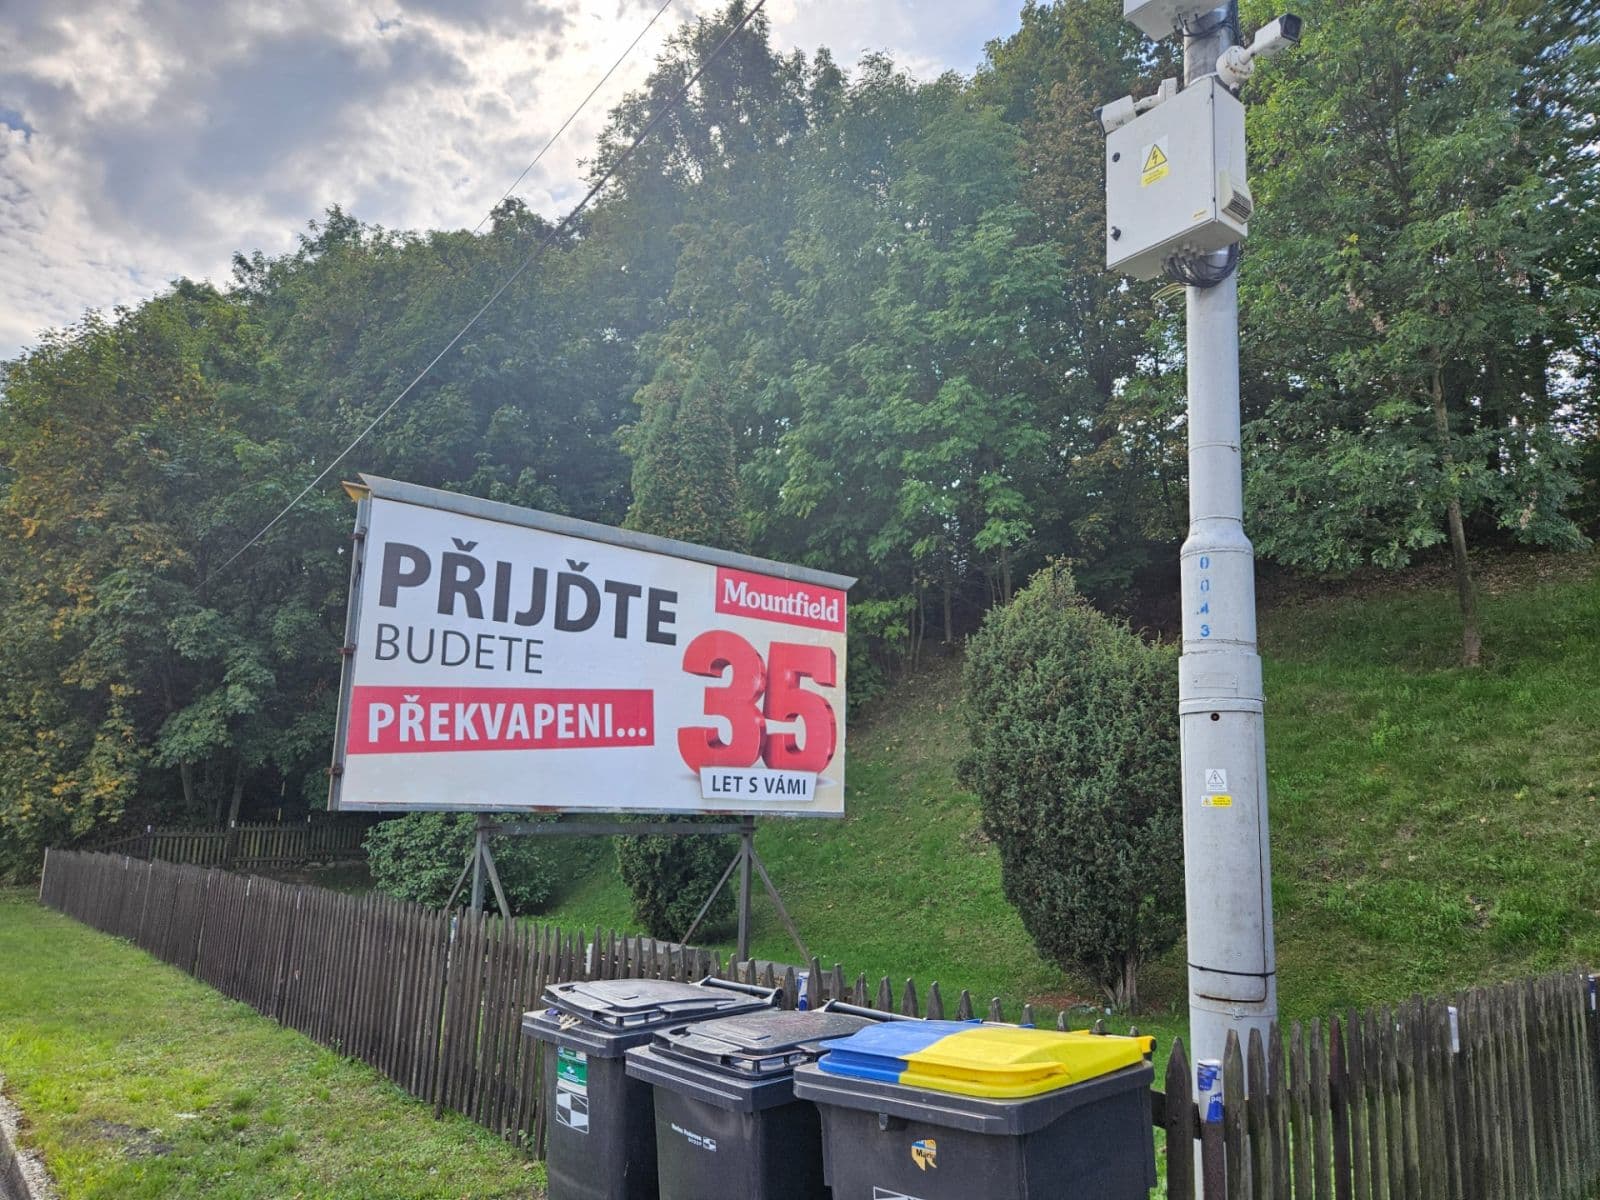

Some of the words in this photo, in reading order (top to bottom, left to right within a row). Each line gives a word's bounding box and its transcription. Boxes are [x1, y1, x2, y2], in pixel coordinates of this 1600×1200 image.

[379, 537, 678, 646] PŘIJĎTE
[723, 579, 840, 623] Mountfield
[375, 623, 544, 674] BUDETE
[368, 695, 647, 743] PŘEKVAPENI...
[677, 630, 837, 776] 35
[711, 775, 744, 793] LET
[749, 777, 758, 793] S
[765, 774, 807, 795] VÁMI
